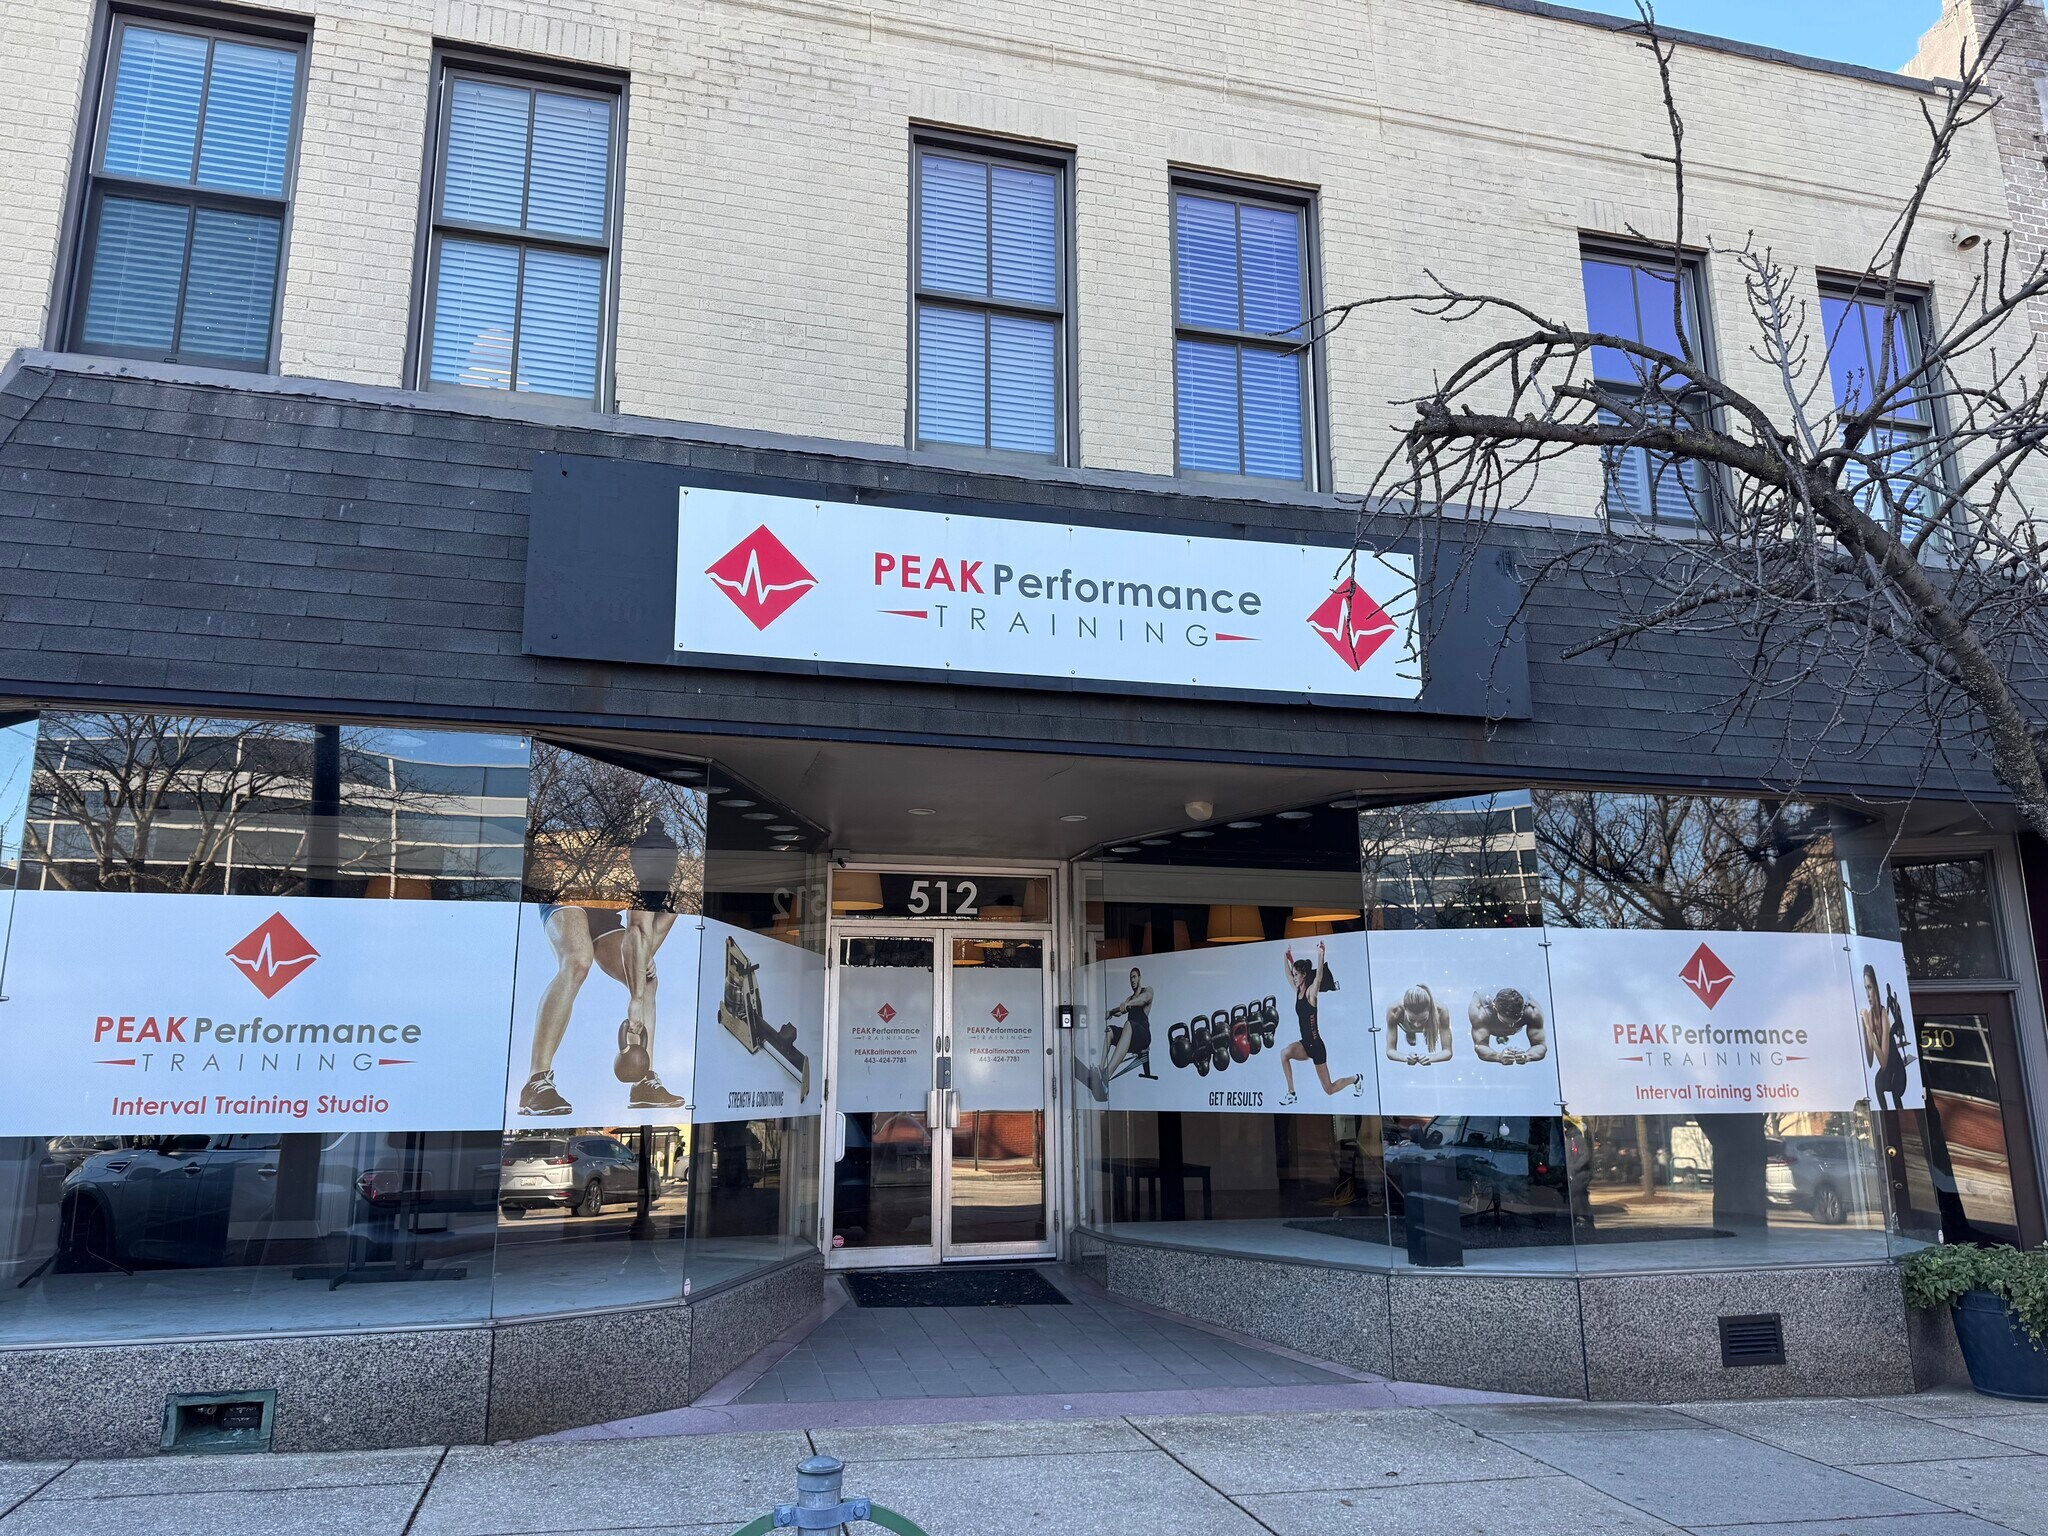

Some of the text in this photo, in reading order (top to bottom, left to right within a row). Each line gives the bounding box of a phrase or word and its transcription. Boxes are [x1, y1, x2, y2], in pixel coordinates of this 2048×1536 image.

[874, 552, 1262, 616] PEAK Performance
[935, 605, 1208, 647] TRAINING
[907, 880, 978, 915] 512
[94, 1016, 422, 1043] PEAK Performance
[986, 1026, 1032, 1034] Performance
[1613, 1023, 1808, 1045] PEAK Performance
[1920, 1029, 1955, 1048] 510
[142, 1054, 373, 1072] TRAINING
[1644, 1051, 1783, 1067] TRAINING
[728, 1091, 751, 1109] STRENGTH
[1209, 1091, 1263, 1107] GET RESULTS
[1636, 1083, 1799, 1102] Interval Training Studio
[112, 1094, 389, 1118] Interval Training Studio
